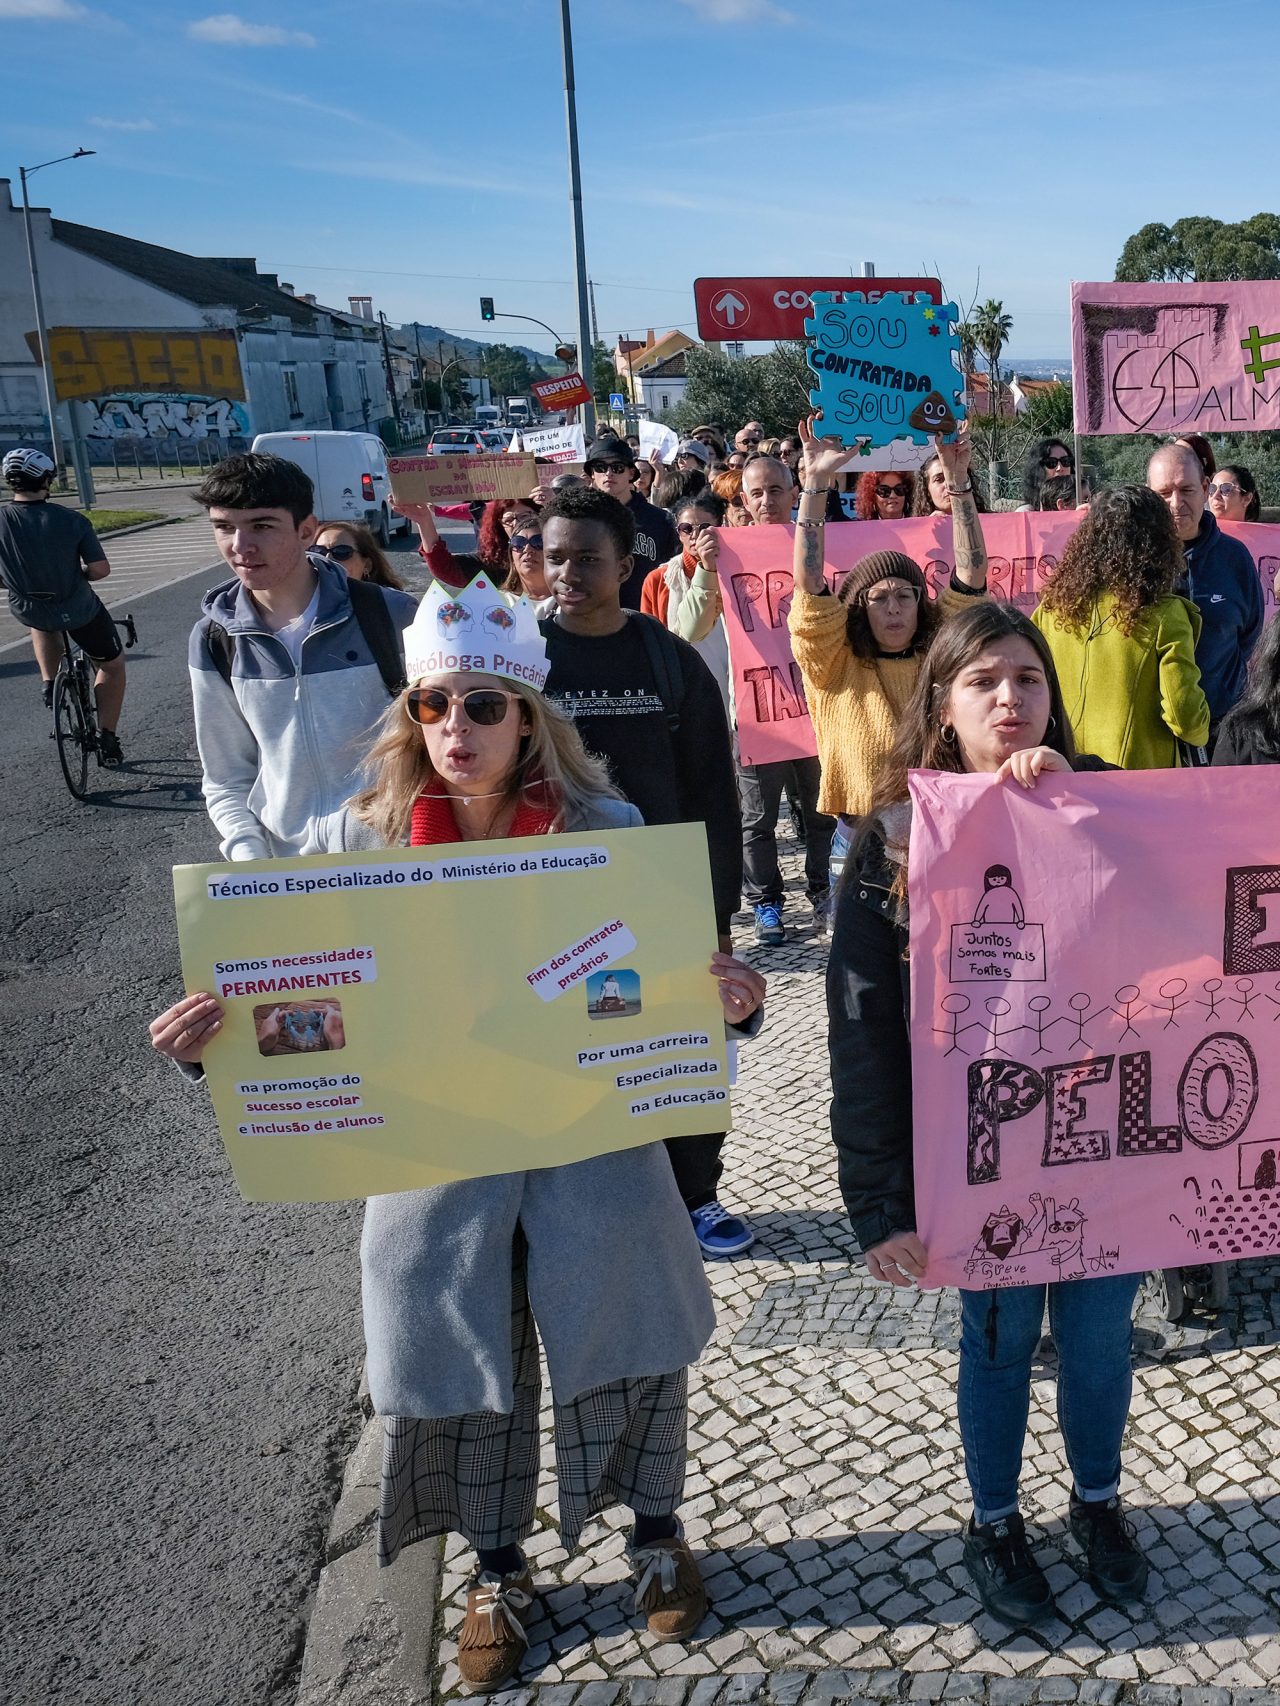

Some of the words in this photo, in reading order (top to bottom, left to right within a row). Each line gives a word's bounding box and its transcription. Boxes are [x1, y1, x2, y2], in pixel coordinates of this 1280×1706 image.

[820, 309, 907, 349] SOU
[810, 349, 931, 393] CONTRATADA
[536, 377, 581, 397] RESPEITO
[834, 389, 904, 425] SOU
[529, 435, 545, 443] POR
[547, 432, 559, 440] UM
[406, 651, 485, 680] Psicóloga
[493, 653, 546, 688] Precária
[565, 690, 608, 699] EYEZ
[624, 689, 645, 697] ON
[208, 877, 280, 898] Técnico
[285, 867, 405, 894] Especializado
[410, 867, 433, 882] do
[441, 860, 516, 880] Ministério
[519, 859, 538, 873] da
[541, 852, 607, 871] Educação
[964, 931, 1012, 947] Juntos
[215, 959, 268, 974] Somos
[272, 948, 373, 968] necessidades
[526, 967, 550, 986] Fim
[550, 953, 571, 970] dos
[571, 920, 624, 957] contratos
[1002, 951, 1036, 962] mais
[558, 951, 609, 990] precários
[222, 970, 362, 998] PERMANENTES
[577, 1051, 605, 1064] Por
[610, 1045, 644, 1058] uma
[649, 1034, 709, 1051] carreira
[240, 1084, 259, 1093] na
[262, 1077, 338, 1094] promoção
[341, 1075, 361, 1085] do
[616, 1062, 718, 1088] Especializada
[246, 1101, 303, 1112] sucesso
[306, 1095, 361, 1109] escolar
[631, 1103, 650, 1114] na
[654, 1089, 726, 1109] Educação
[966, 1031, 1259, 1185] PELO
[239, 1126, 248, 1134] e
[251, 1122, 310, 1134] inclusão
[314, 1120, 332, 1131] de
[336, 1115, 385, 1129] alunos
